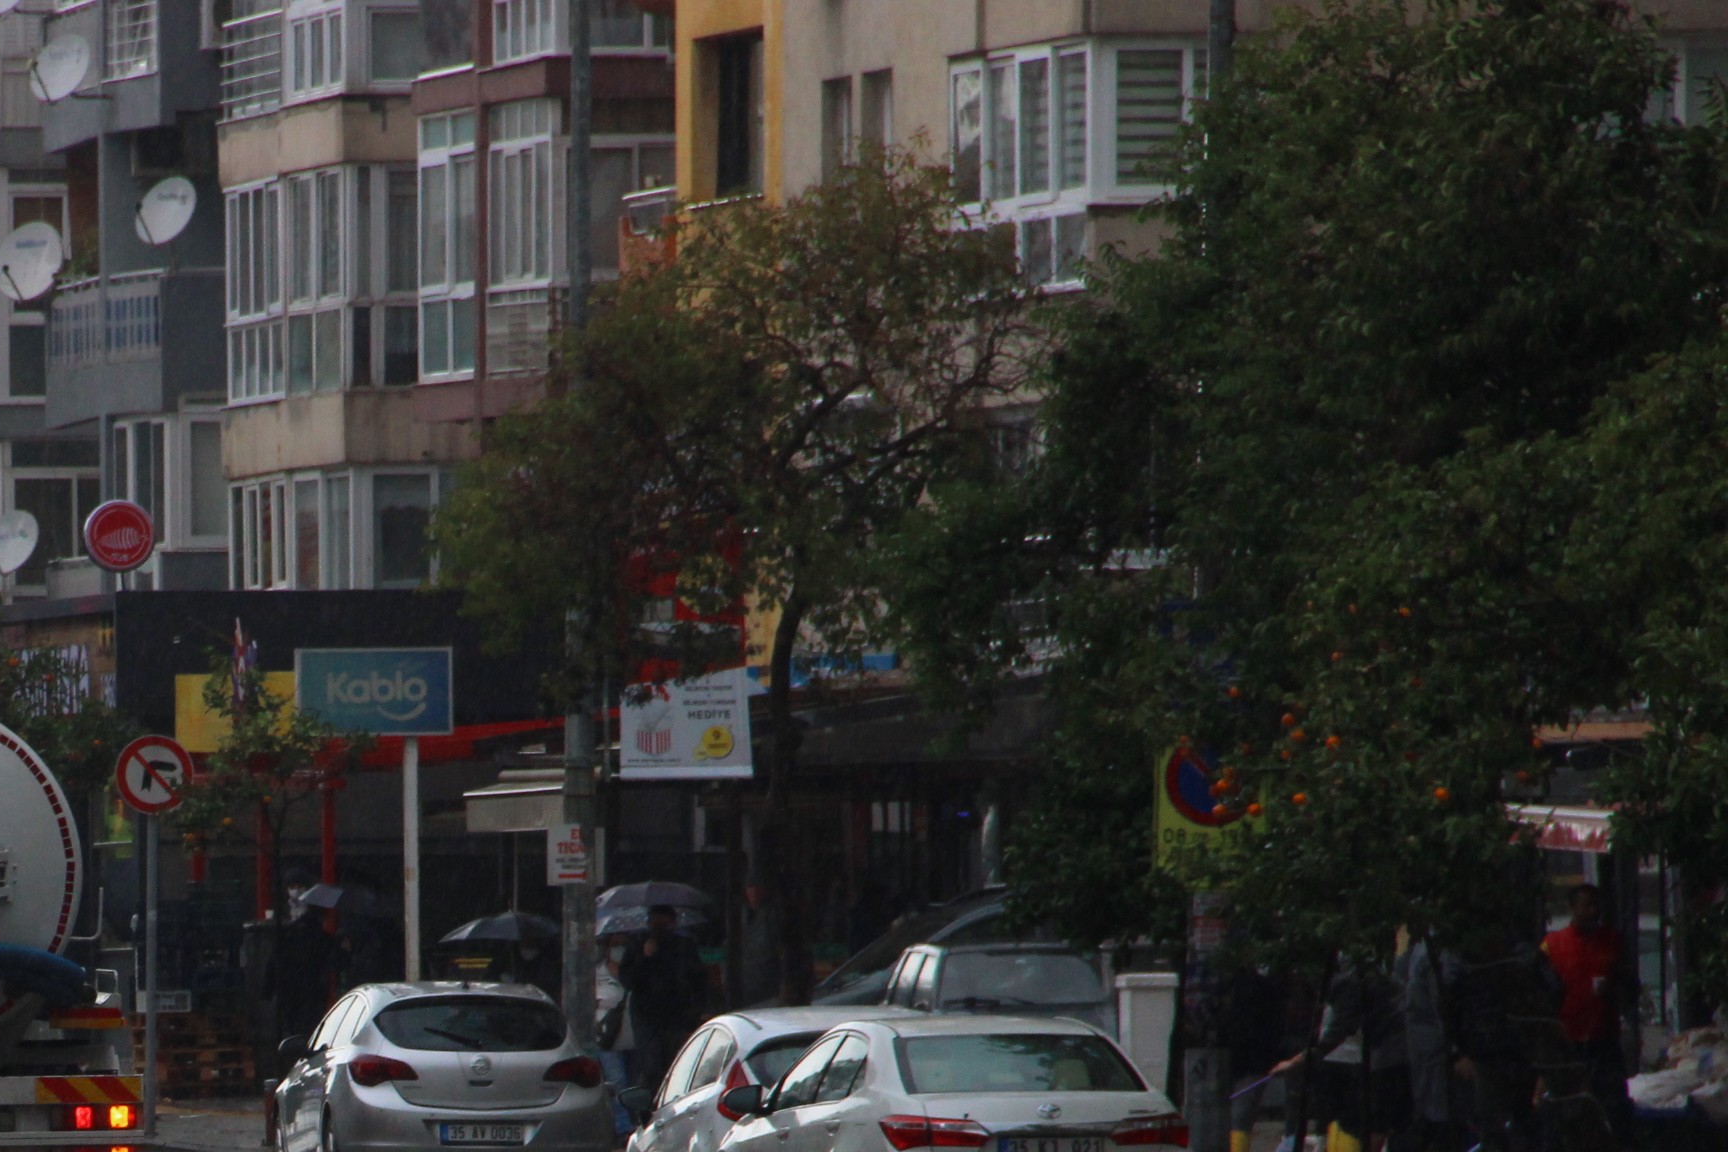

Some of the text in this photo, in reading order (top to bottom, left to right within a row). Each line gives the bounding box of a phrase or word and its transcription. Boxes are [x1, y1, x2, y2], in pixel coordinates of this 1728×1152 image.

[326, 669, 428, 704] Kablo
[450, 1126, 522, 1140] 35 AV 0036
